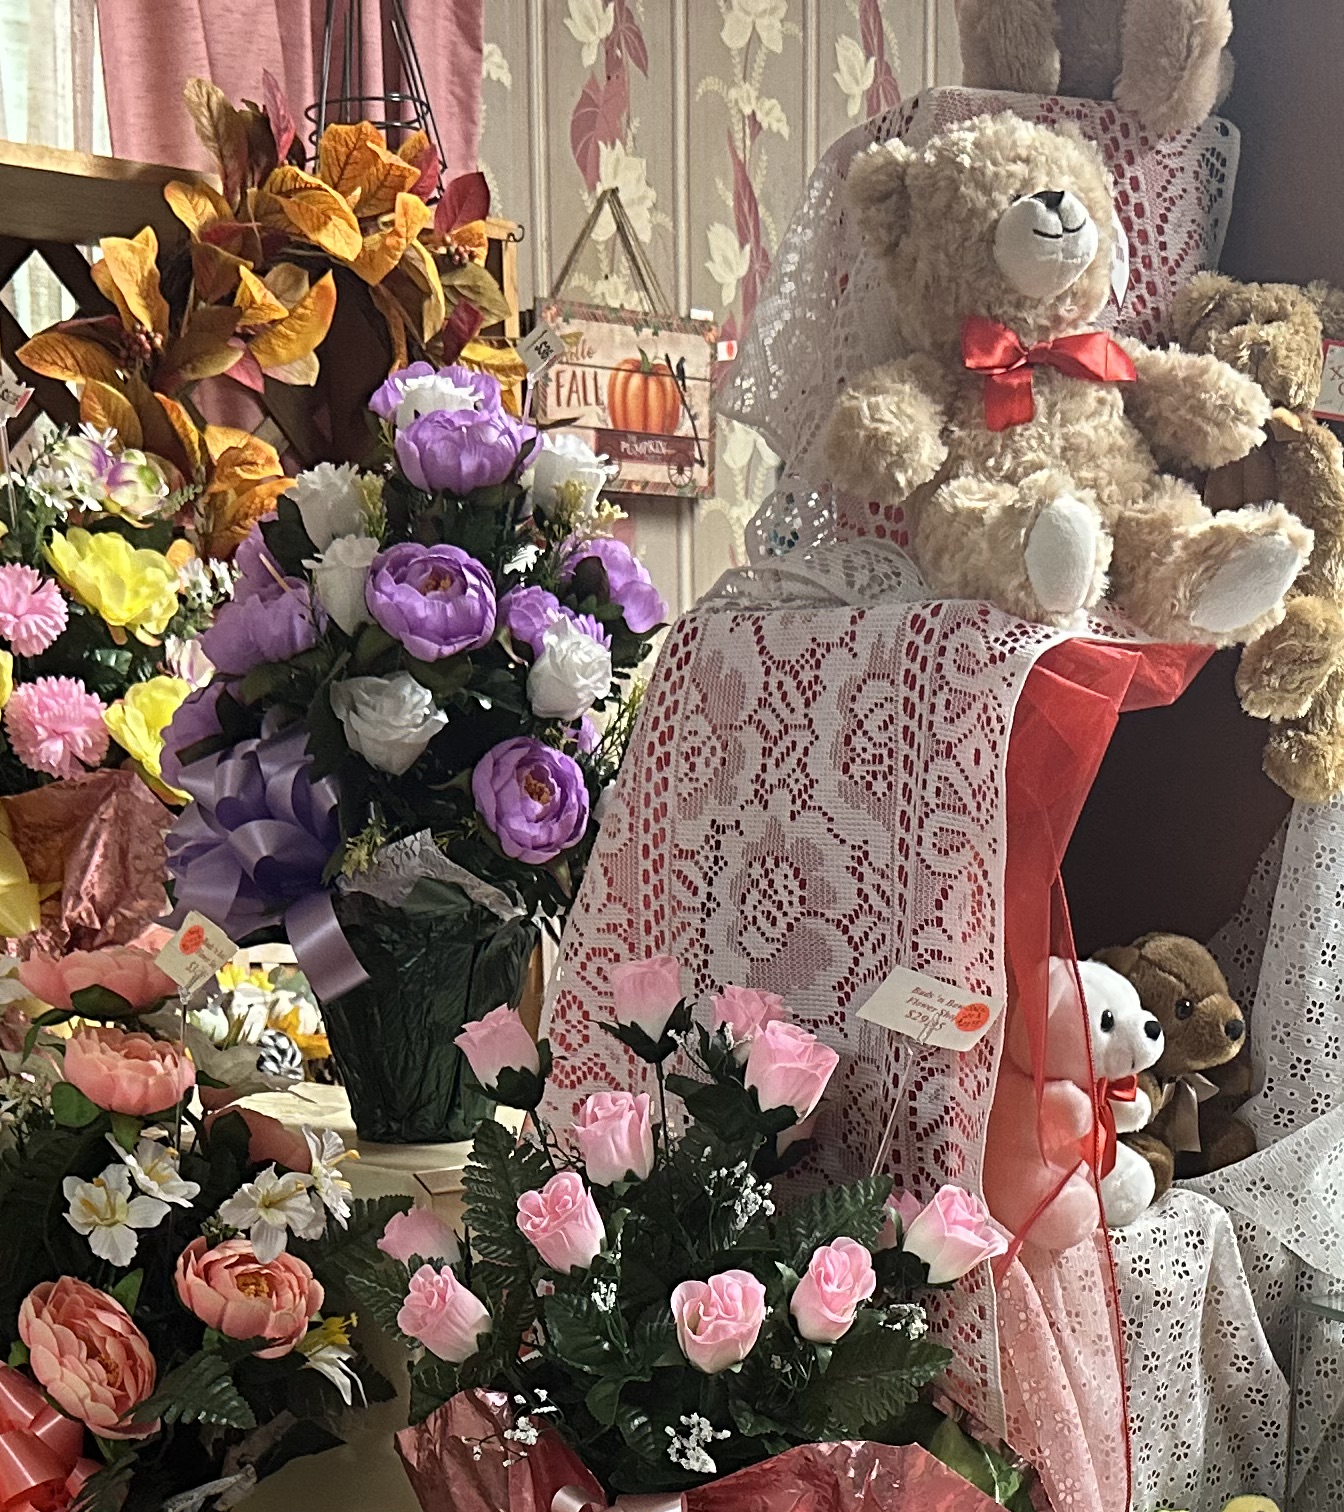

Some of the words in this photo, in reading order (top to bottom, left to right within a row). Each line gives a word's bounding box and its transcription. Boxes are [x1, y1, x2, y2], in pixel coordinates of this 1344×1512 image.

[555, 369, 604, 408] FALL
[911, 986, 935, 999] Buds
[906, 996, 938, 1014] Flower
